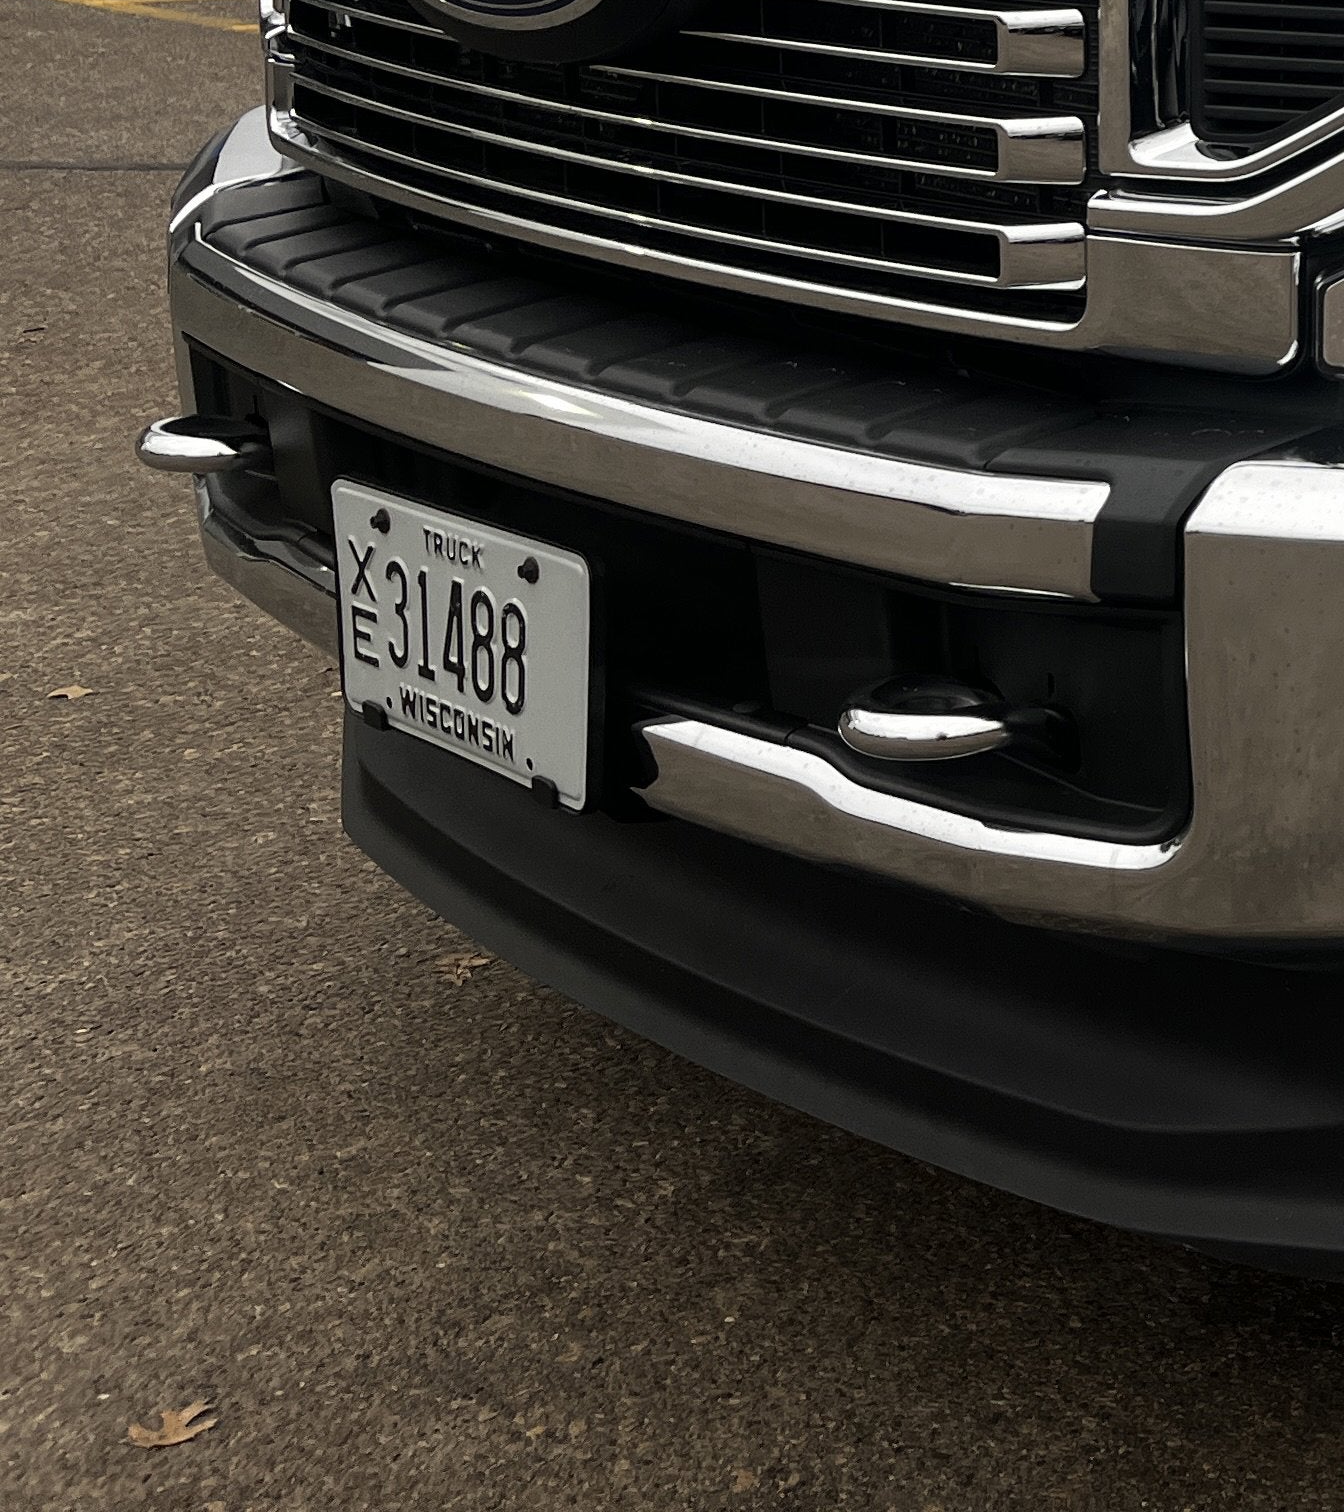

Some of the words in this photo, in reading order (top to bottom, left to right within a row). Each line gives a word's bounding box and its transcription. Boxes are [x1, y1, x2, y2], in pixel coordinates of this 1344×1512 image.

[422, 526, 484, 568] TRUCK
[386, 557, 528, 716] 31488
[400, 685, 515, 762] WISCONSIN
